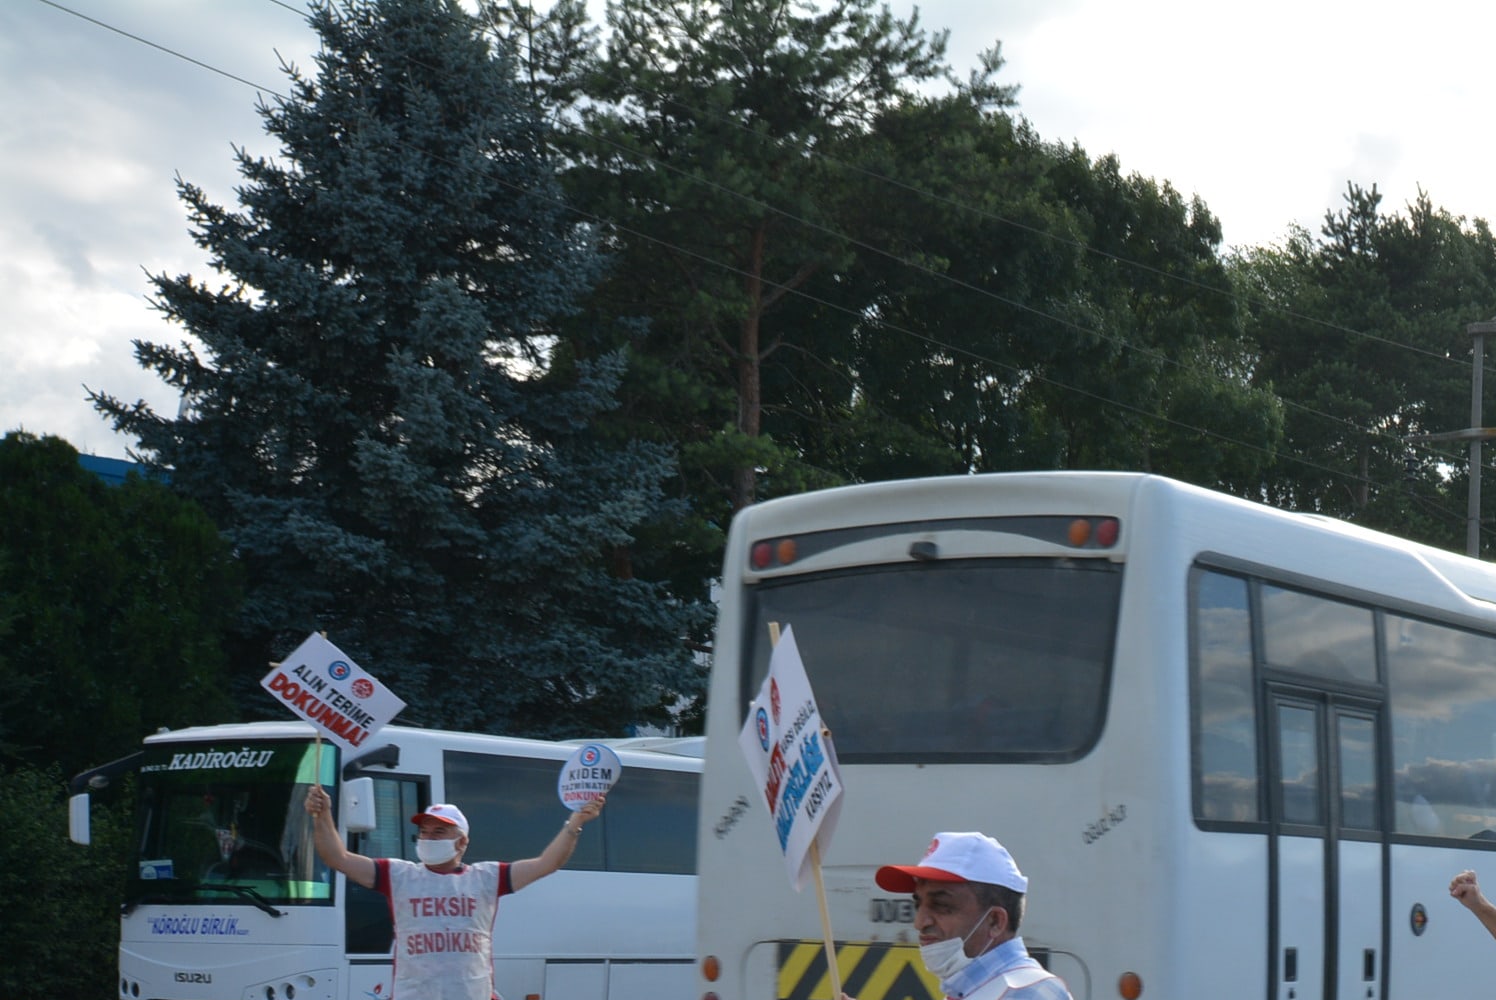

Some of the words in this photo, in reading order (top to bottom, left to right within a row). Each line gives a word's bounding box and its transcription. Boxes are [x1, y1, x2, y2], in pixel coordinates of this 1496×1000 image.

[292, 664, 328, 693] ALIN
[325, 688, 375, 728] TERİME
[268, 672, 369, 747] DOKUNMA!
[168, 747, 274, 770] KADİROĞLU
[569, 767, 612, 781] KIDEM
[409, 894, 477, 917] TEKSİF
[174, 972, 212, 984] ISUZU
